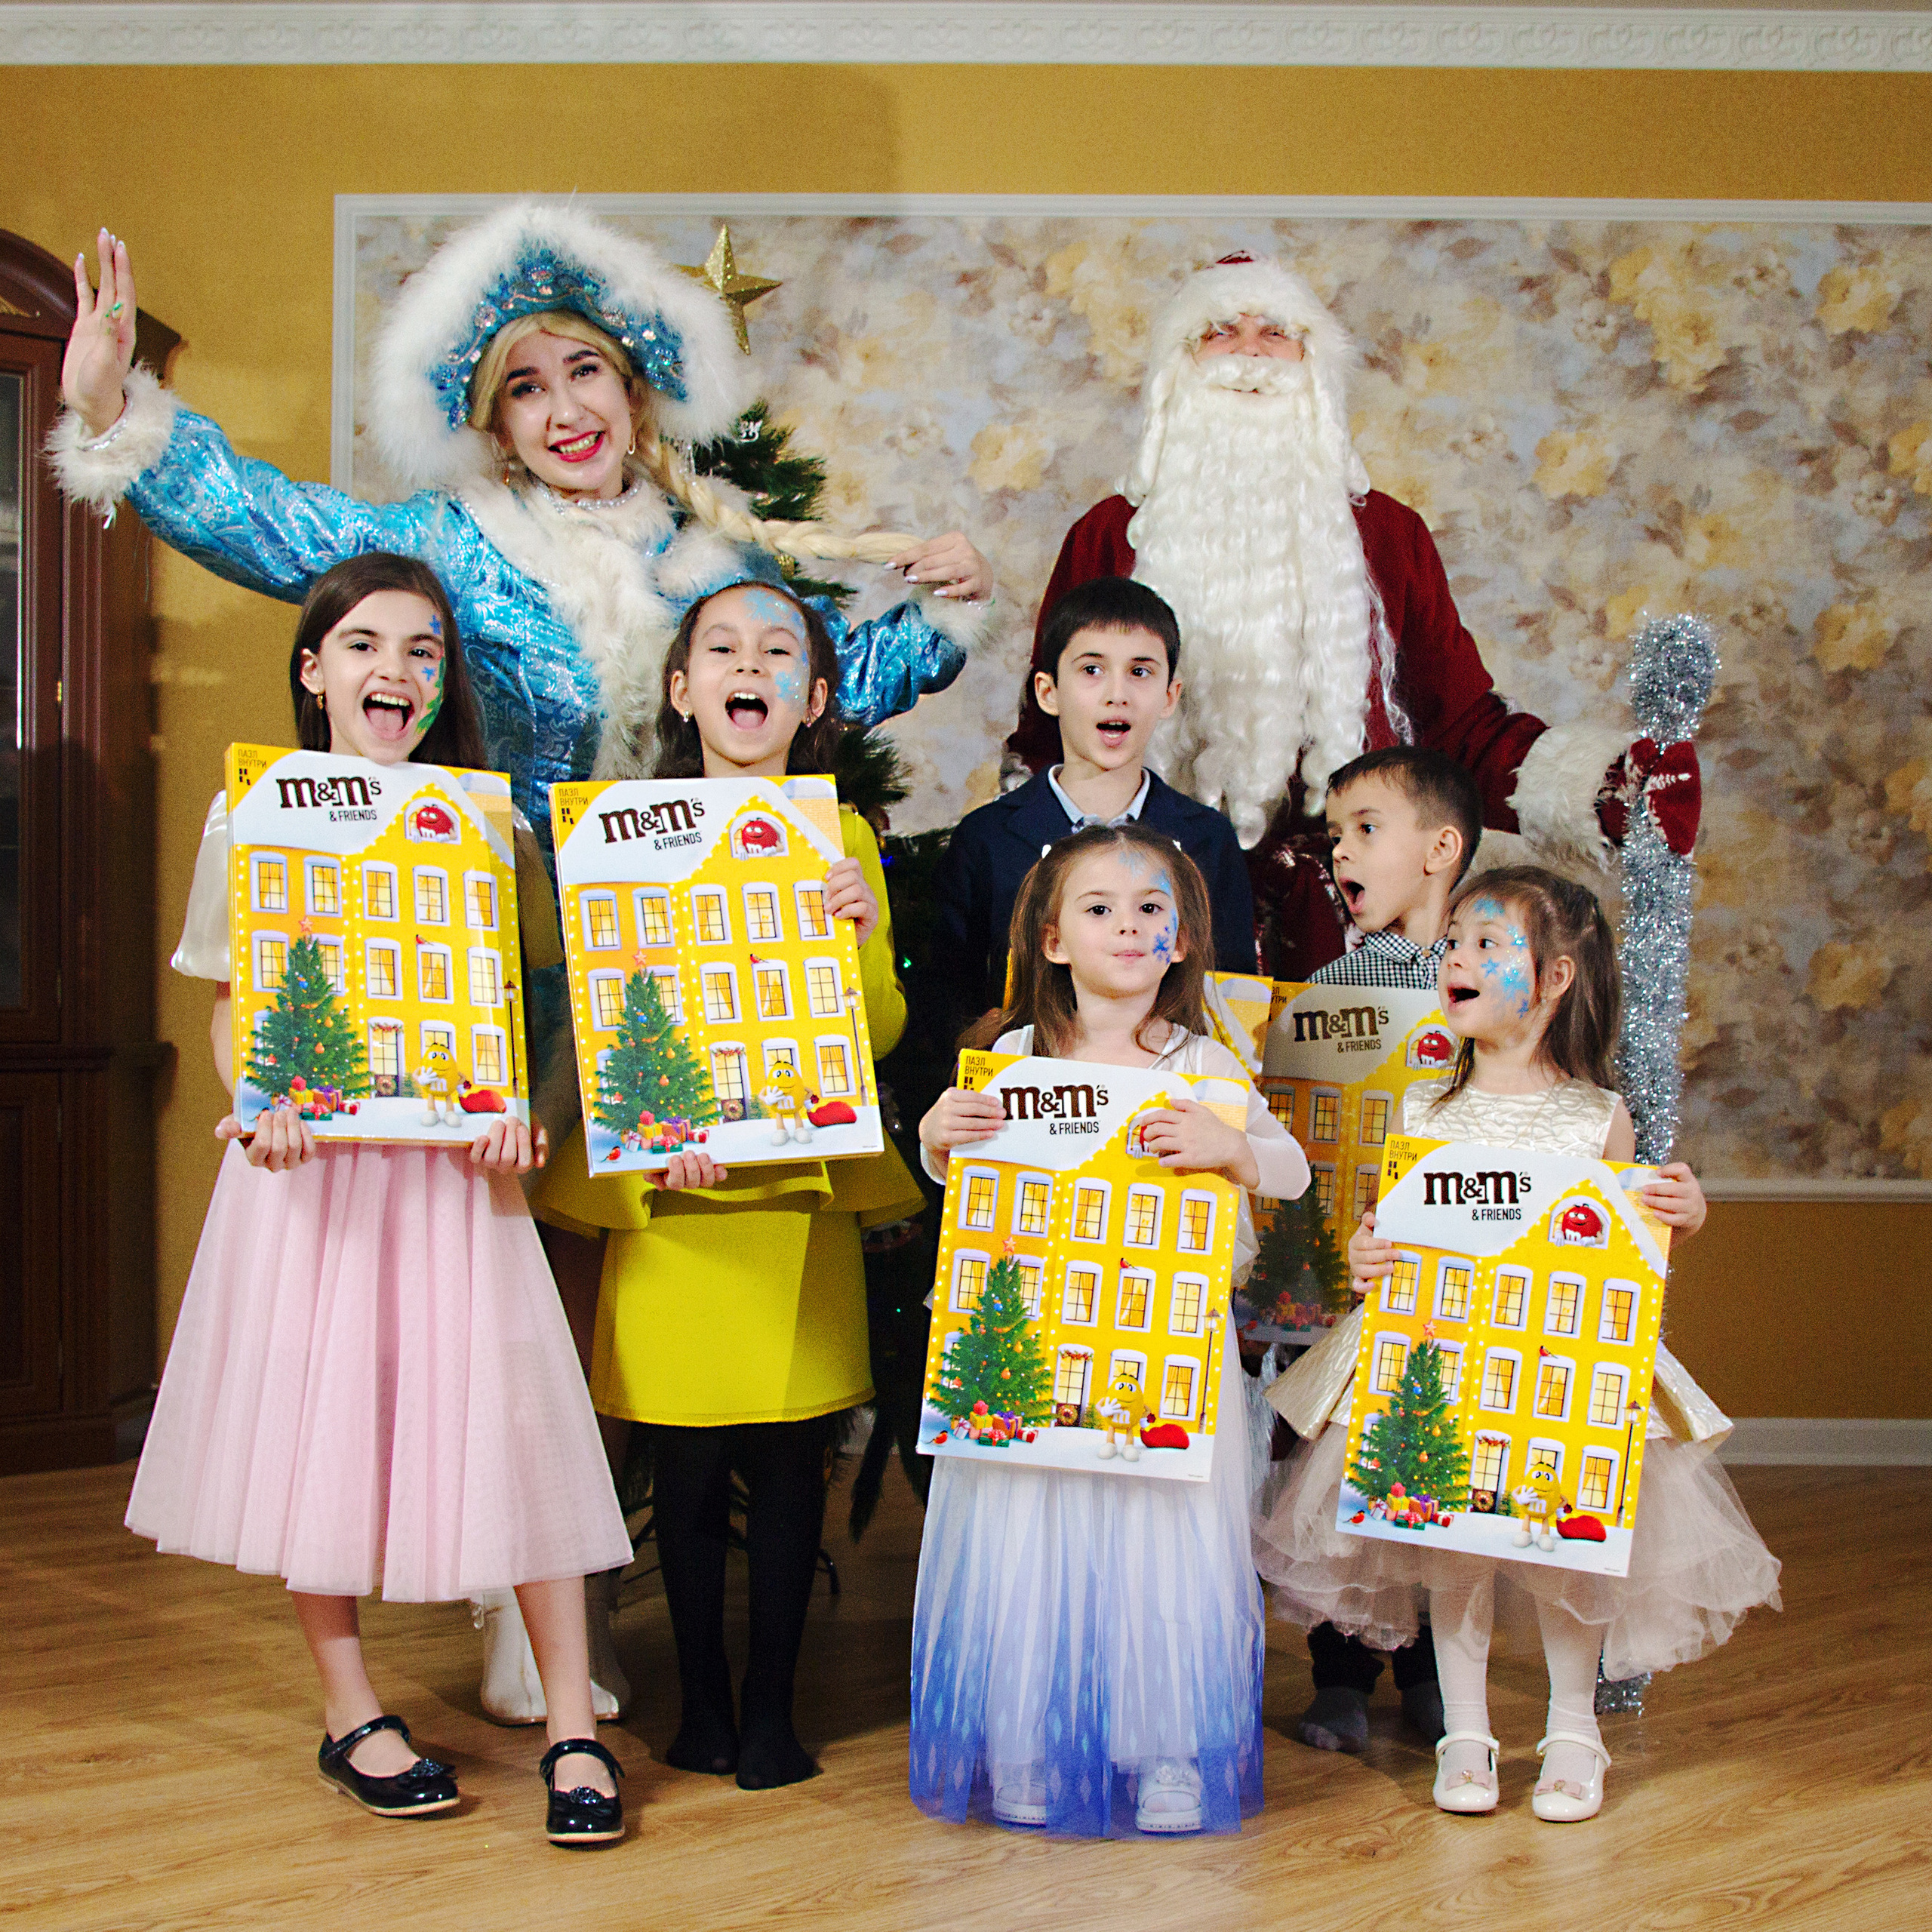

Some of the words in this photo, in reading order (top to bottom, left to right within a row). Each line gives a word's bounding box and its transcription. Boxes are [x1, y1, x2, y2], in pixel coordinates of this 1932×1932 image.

[237, 749, 258, 758] ПАЗЛ
[237, 758, 267, 768] ВНУТРИ
[559, 788, 579, 797] ПАЗЛ
[560, 796, 589, 806] ВНУТРИ
[330, 811, 337, 822] &
[339, 809, 377, 821] FRIENDS
[654, 839, 662, 851] &
[663, 832, 702, 848] FRIENDS
[1337, 1042, 1345, 1054] &
[1346, 1039, 1382, 1053] FRIENDS
[966, 1055, 986, 1066] ПАЗЛ
[965, 1065, 993, 1077] ВНУТРИ
[1049, 1124, 1057, 1135] &
[1059, 1121, 1100, 1134] FRIENDS
[1390, 1140, 1410, 1151] ПАЗЛ
[1389, 1149, 1417, 1161] ВНУТРИ
[1472, 1209, 1479, 1220] &
[1481, 1208, 1521, 1220] FRIENDS
